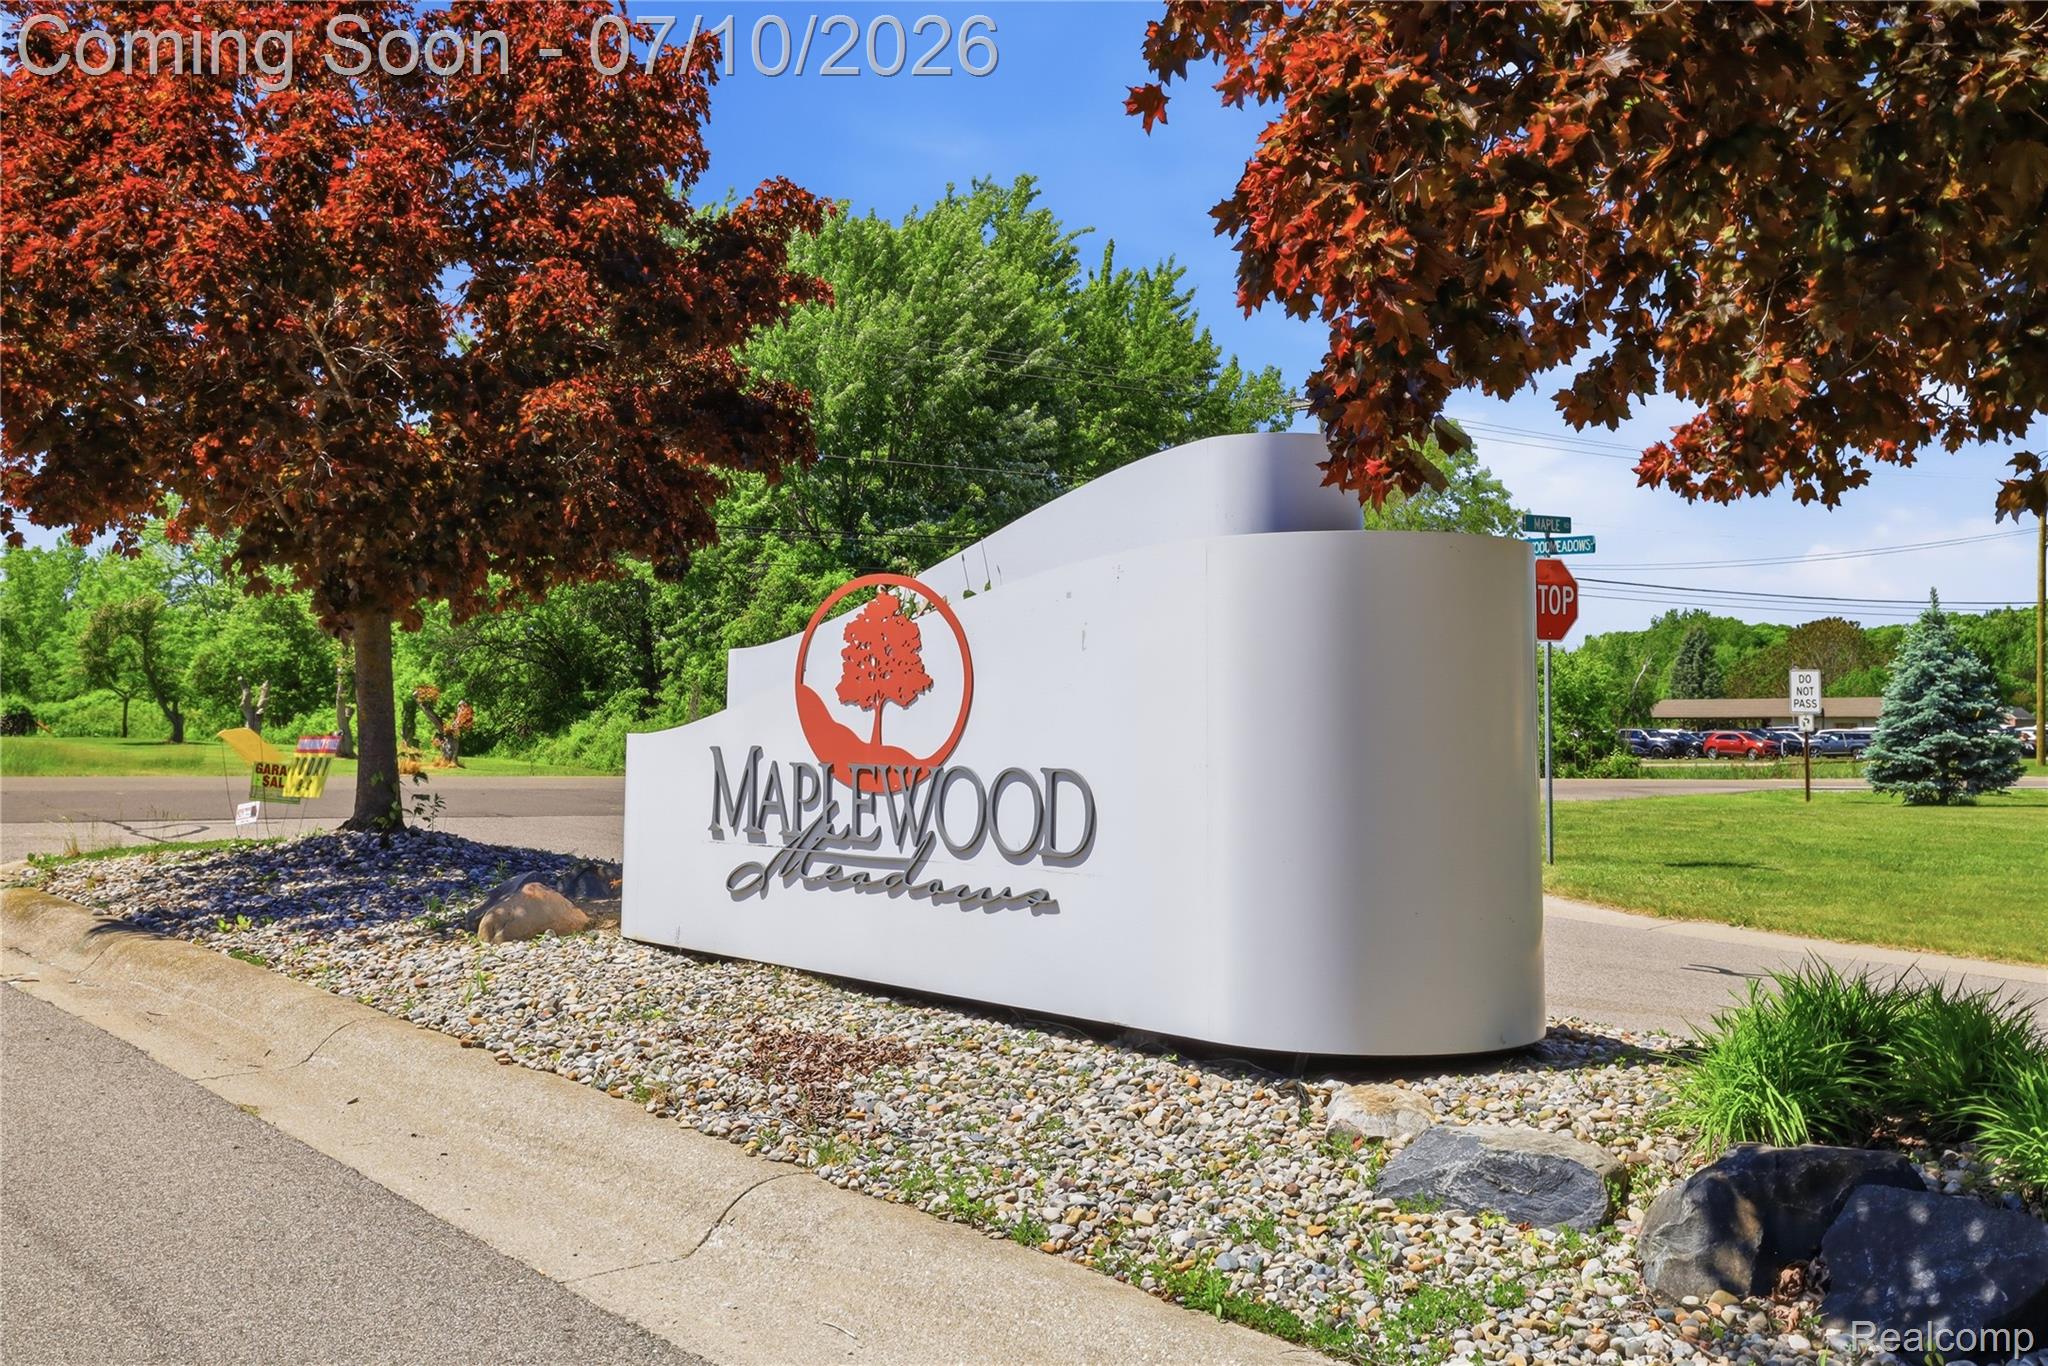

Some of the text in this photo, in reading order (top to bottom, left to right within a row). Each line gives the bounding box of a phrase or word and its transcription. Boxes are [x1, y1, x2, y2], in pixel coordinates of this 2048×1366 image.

[1534, 516, 1561, 532] MAPLE
[1537, 584, 1575, 615] TOP
[1798, 674, 1812, 684] DO
[1796, 687, 1814, 696] NOT
[1793, 698, 1818, 709] PASS
[255, 762, 288, 776] GARA
[262, 775, 285, 789] SAL
[708, 745, 1097, 866] MAPLEWOOD
[726, 801, 1060, 915] Meadows
